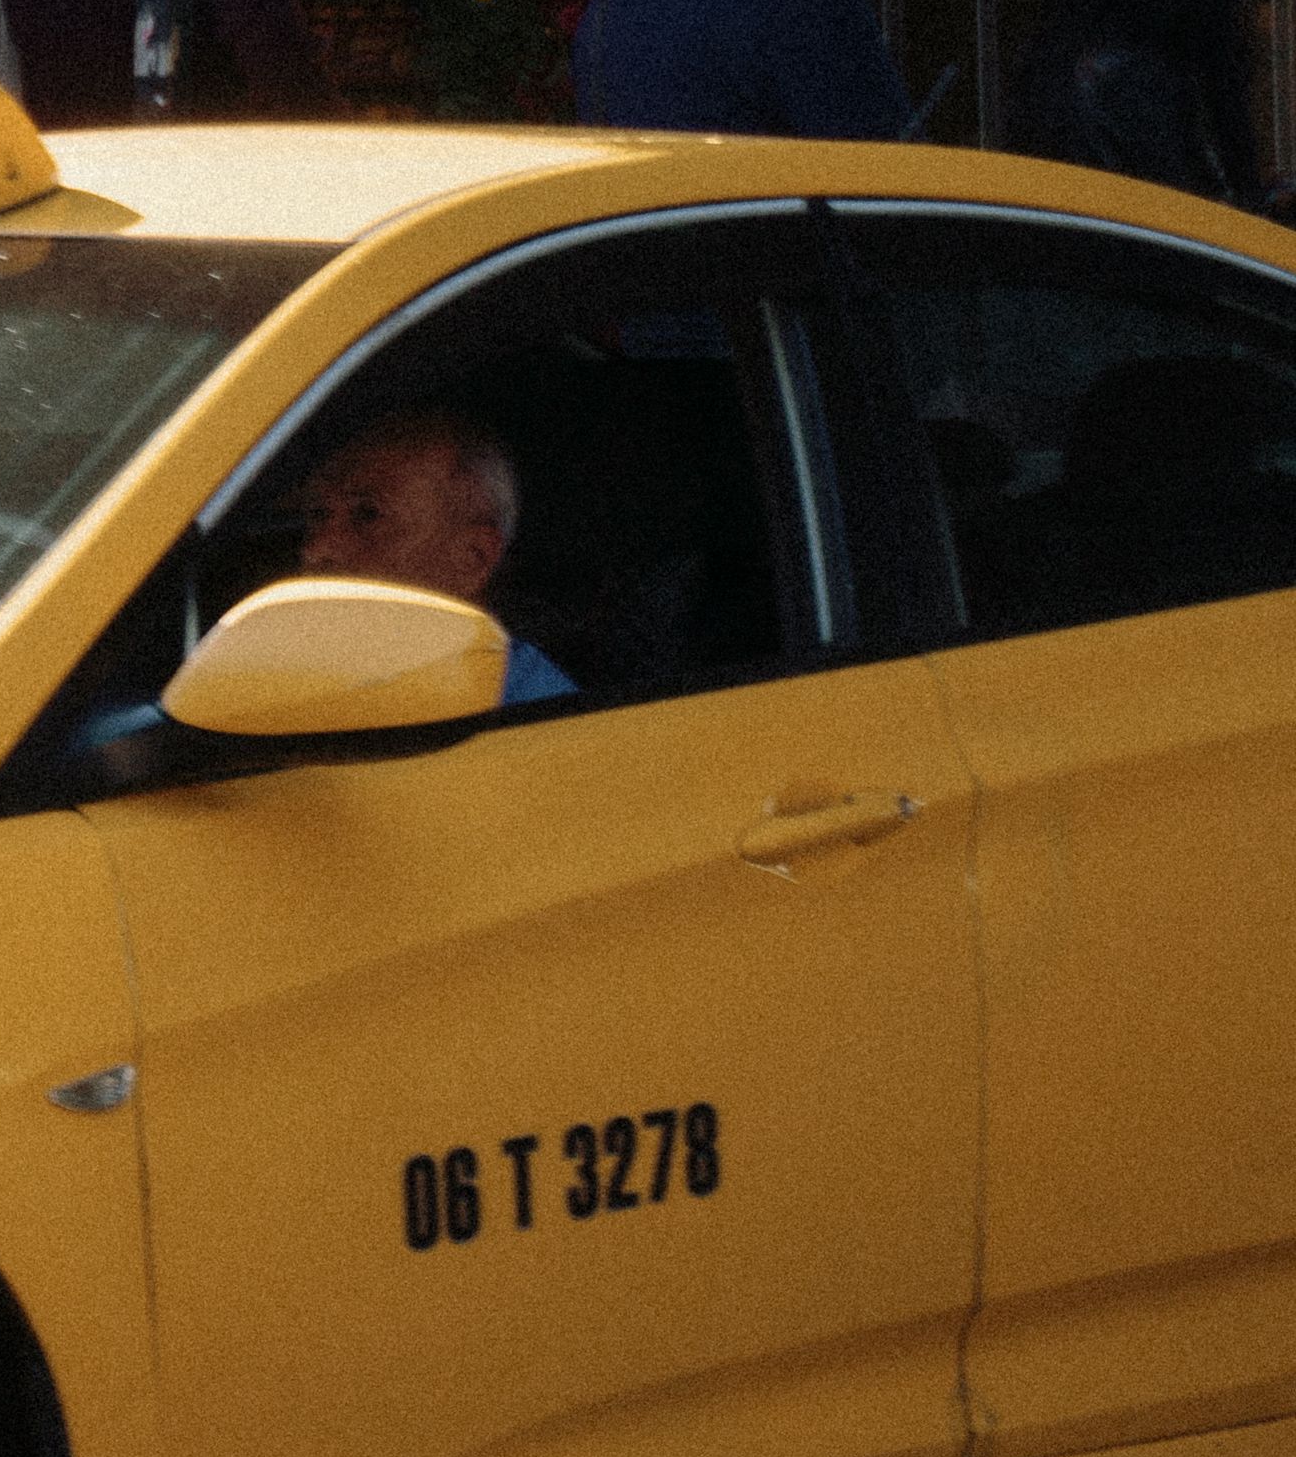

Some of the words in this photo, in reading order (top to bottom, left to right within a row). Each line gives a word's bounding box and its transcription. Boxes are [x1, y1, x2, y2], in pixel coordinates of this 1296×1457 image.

[403, 1146, 481, 1251] 06
[501, 1133, 539, 1231] T
[563, 1101, 721, 1221] 3278
